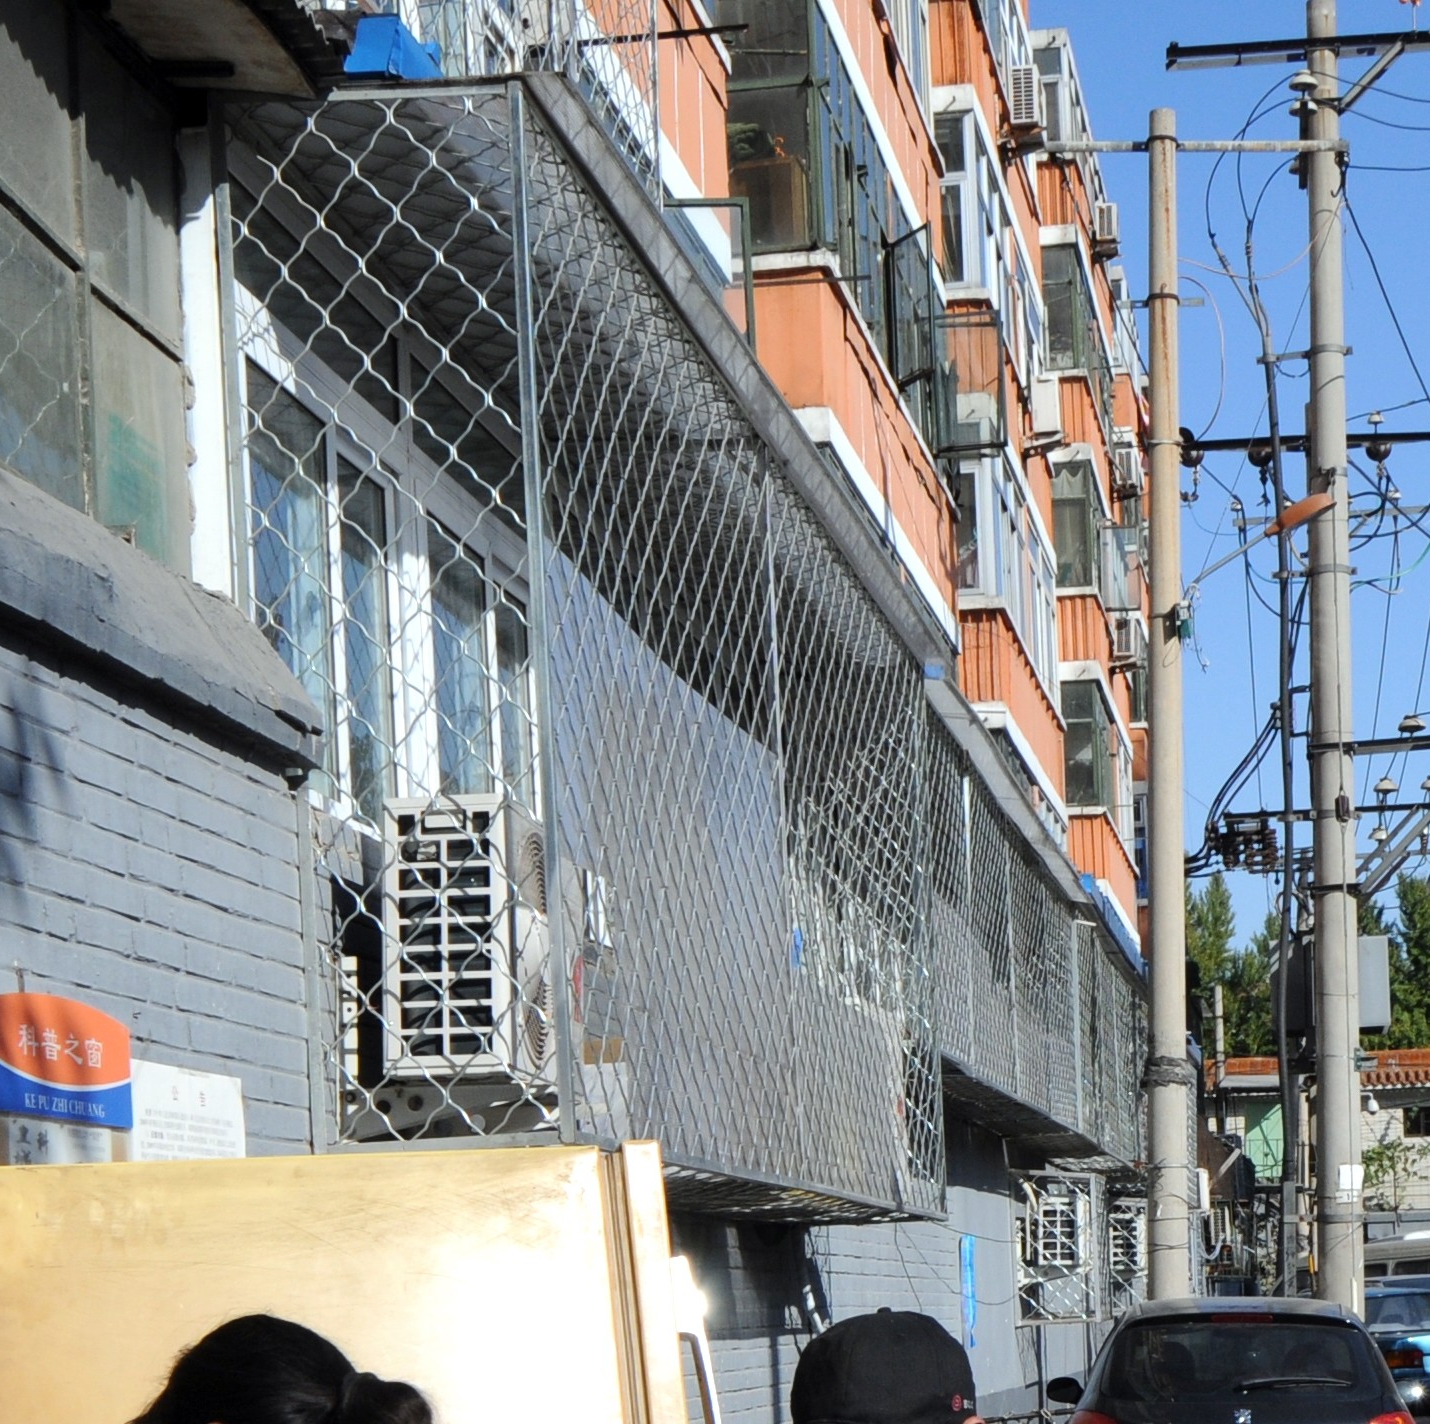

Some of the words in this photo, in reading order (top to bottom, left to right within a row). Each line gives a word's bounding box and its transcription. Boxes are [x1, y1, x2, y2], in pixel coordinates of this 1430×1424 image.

[18, 1024, 103, 1069] 科普之窗
[24, 1092, 37, 1109] KE
[39, 1094, 51, 1110] PU
[52, 1096, 68, 1113] ZHI
[69, 1099, 106, 1119] CHUANG
